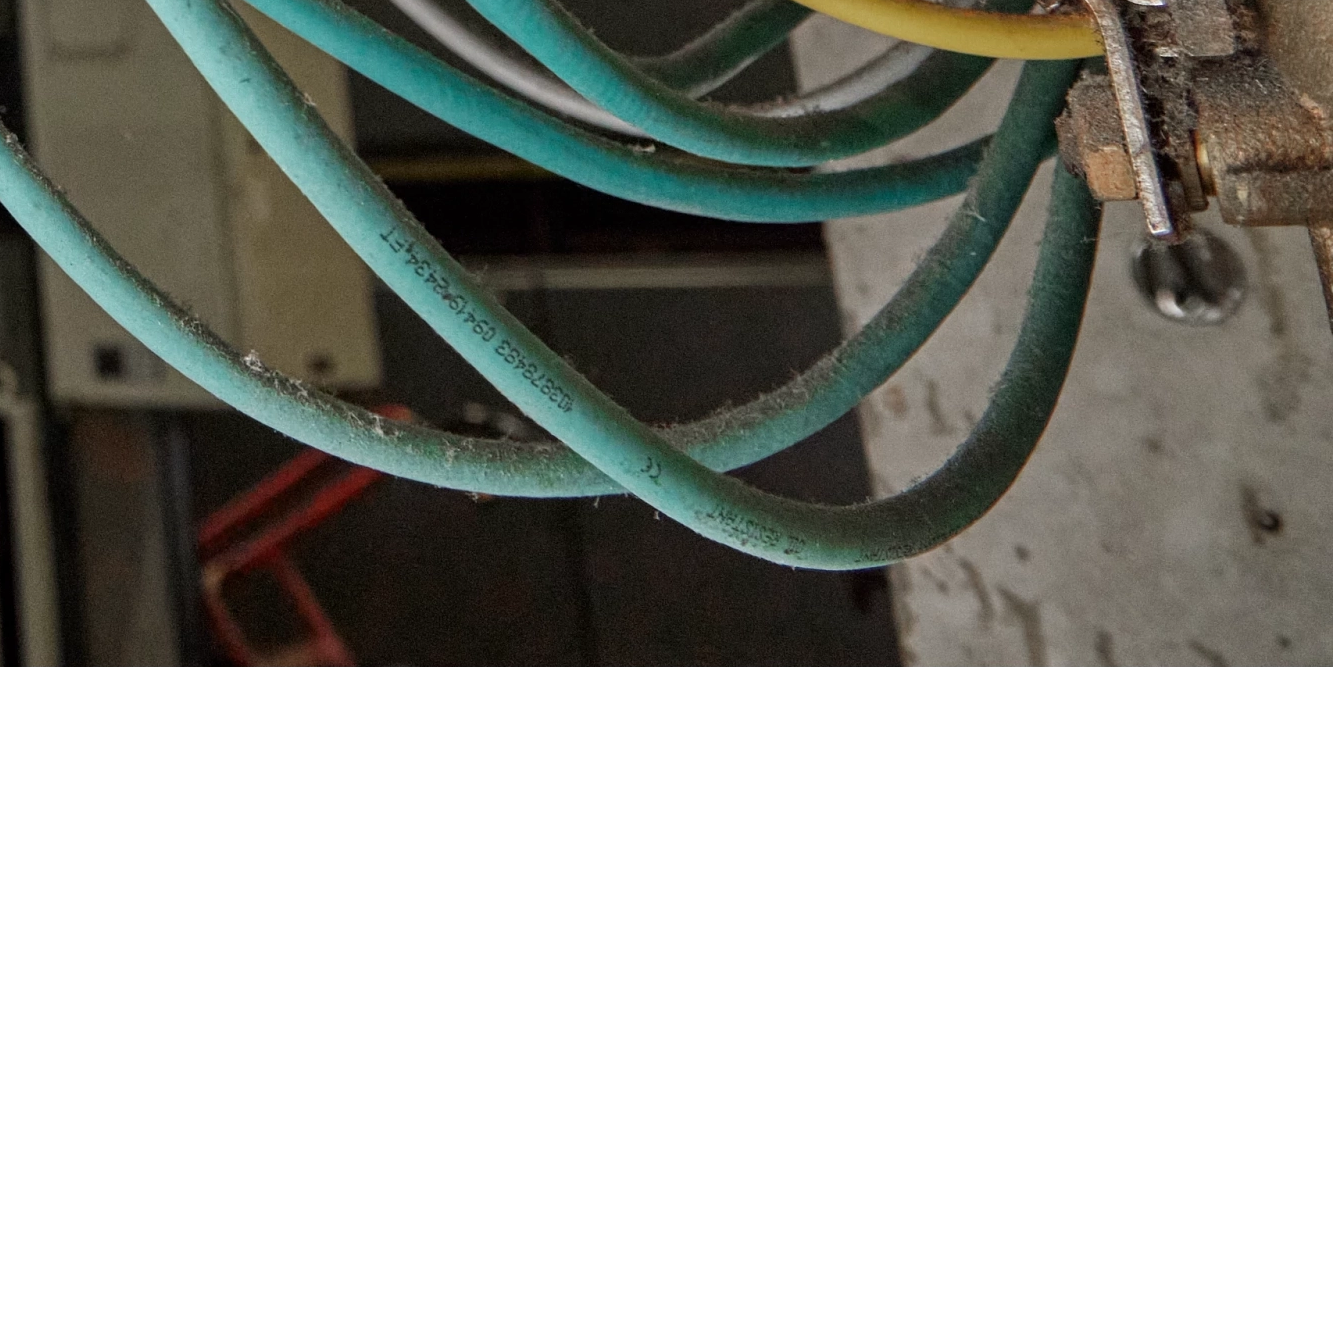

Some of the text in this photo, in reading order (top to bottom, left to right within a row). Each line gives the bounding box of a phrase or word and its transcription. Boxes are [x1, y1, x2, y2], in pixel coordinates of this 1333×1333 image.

[379, 225, 408, 253] FT
[448, 294, 496, 342] 09419
[495, 339, 574, 413] 103878483
